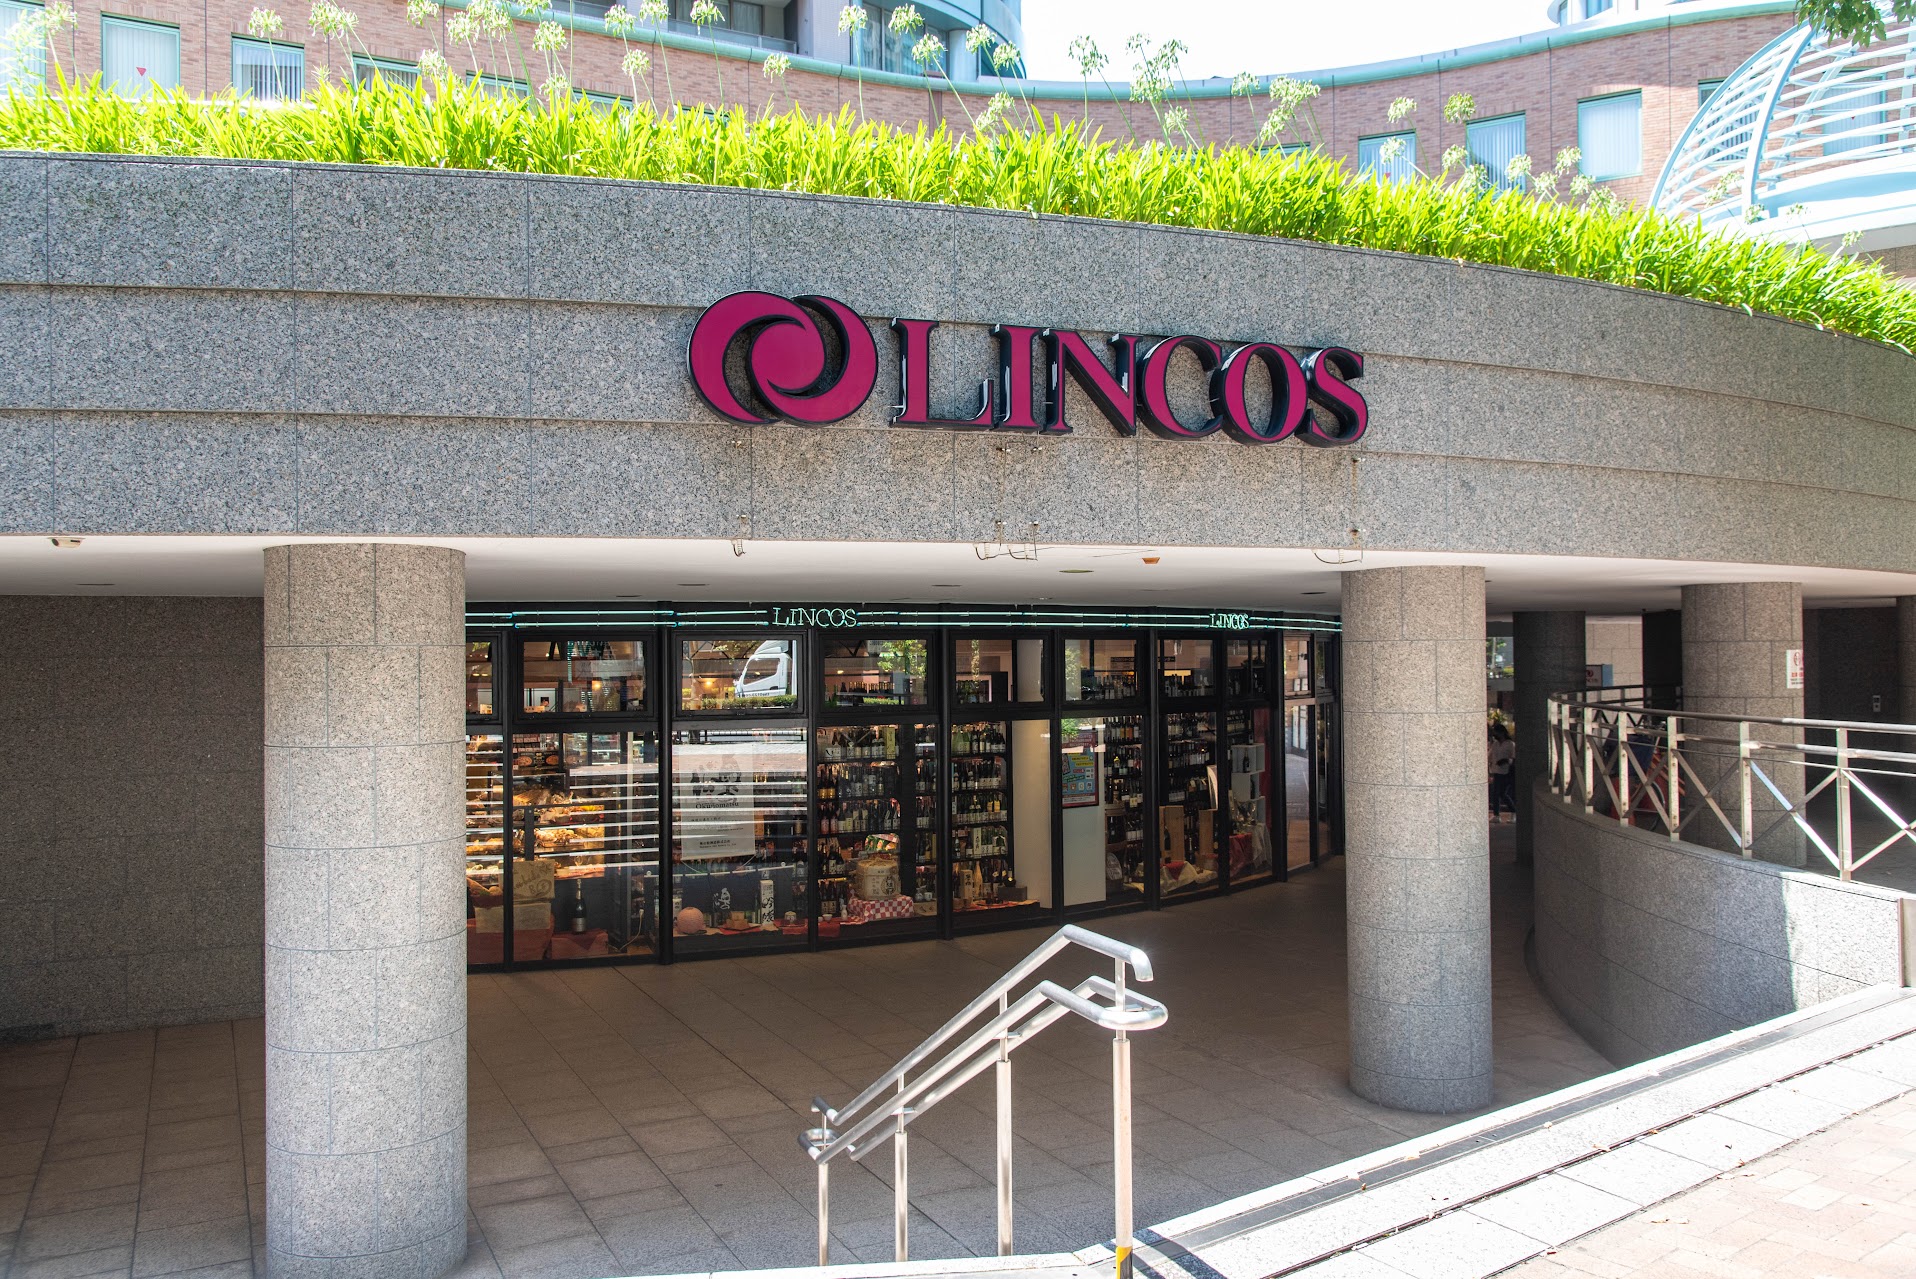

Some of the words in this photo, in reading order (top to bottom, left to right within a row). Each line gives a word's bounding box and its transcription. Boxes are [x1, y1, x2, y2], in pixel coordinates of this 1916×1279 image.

[891, 317, 1369, 446] LINCOS
[772, 607, 857, 627] LINCOS
[1209, 613, 1250, 629] LINCOS
